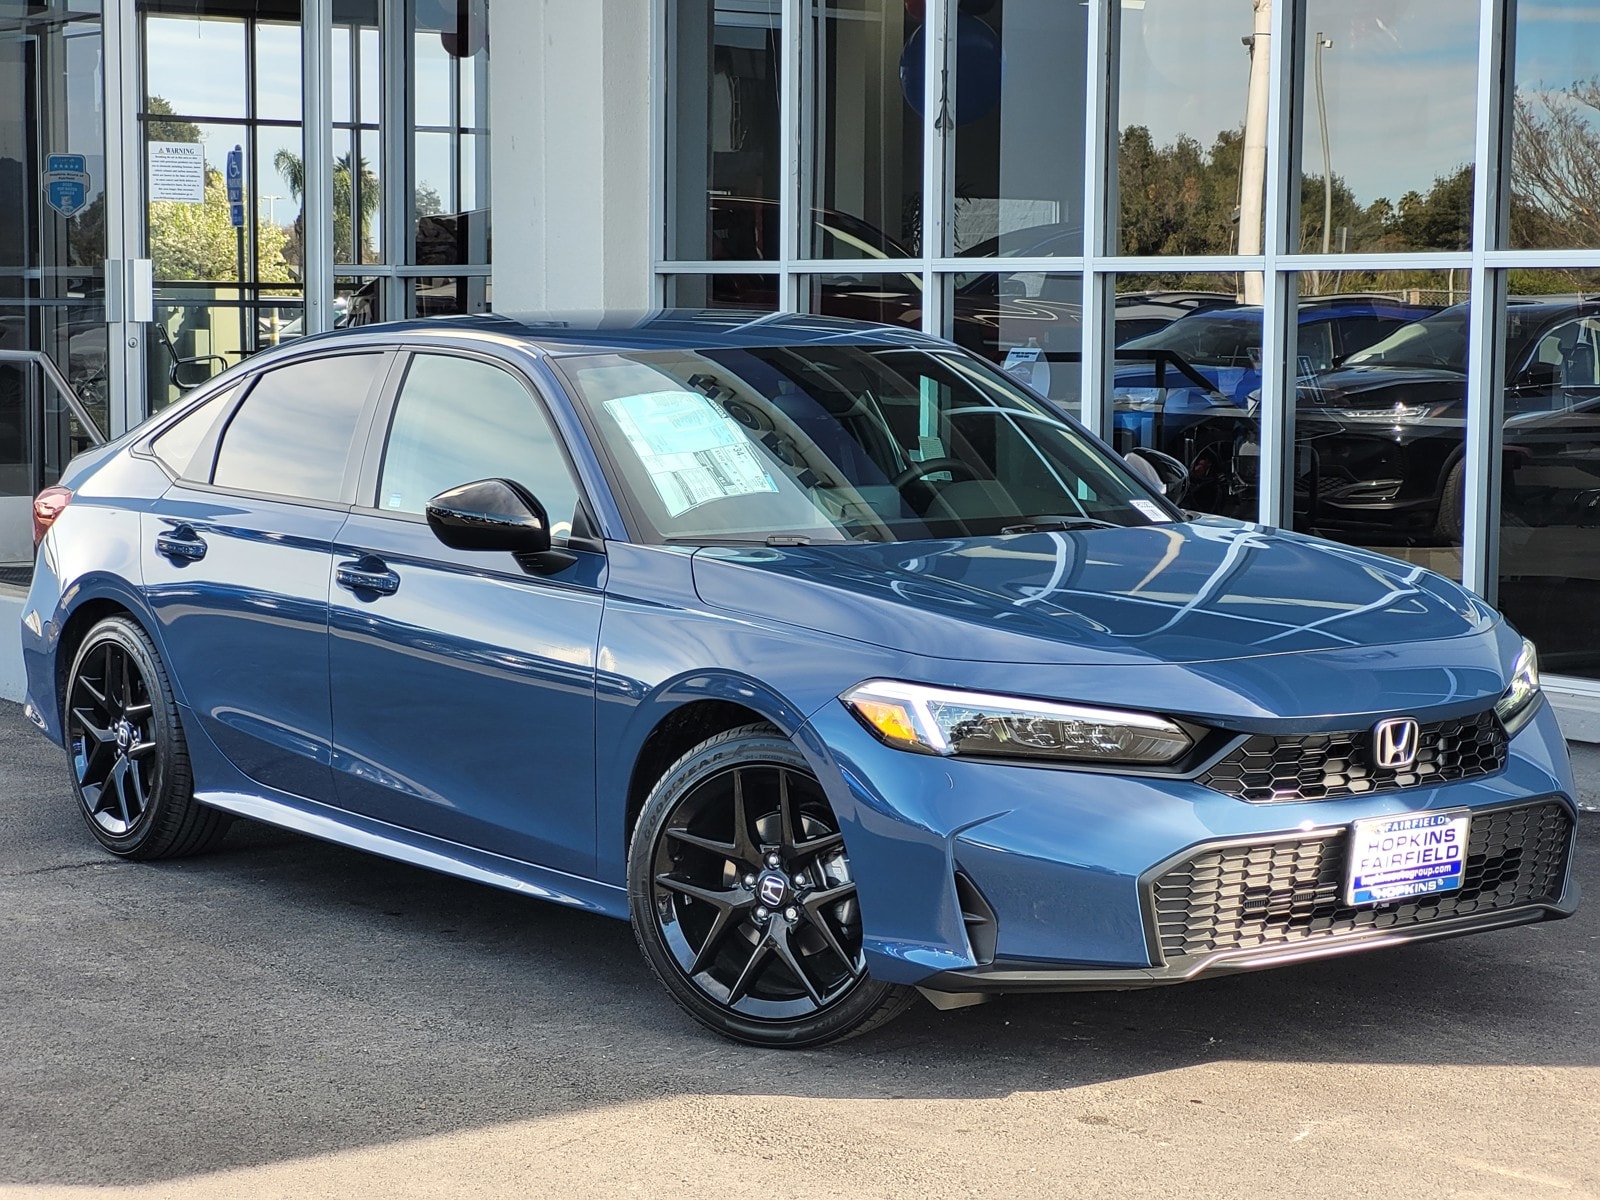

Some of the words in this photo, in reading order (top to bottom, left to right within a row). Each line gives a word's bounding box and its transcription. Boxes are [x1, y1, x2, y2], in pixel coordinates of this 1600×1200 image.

[165, 147, 195, 155] WARNING
[645, 752, 724, 839] GOODYEAR
[1384, 815, 1445, 832] FAIRFIELD
[1368, 828, 1456, 853] HOPKINS
[1360, 845, 1459, 872] FAIRFIELD
[1374, 880, 1437, 898] HOPKINS
